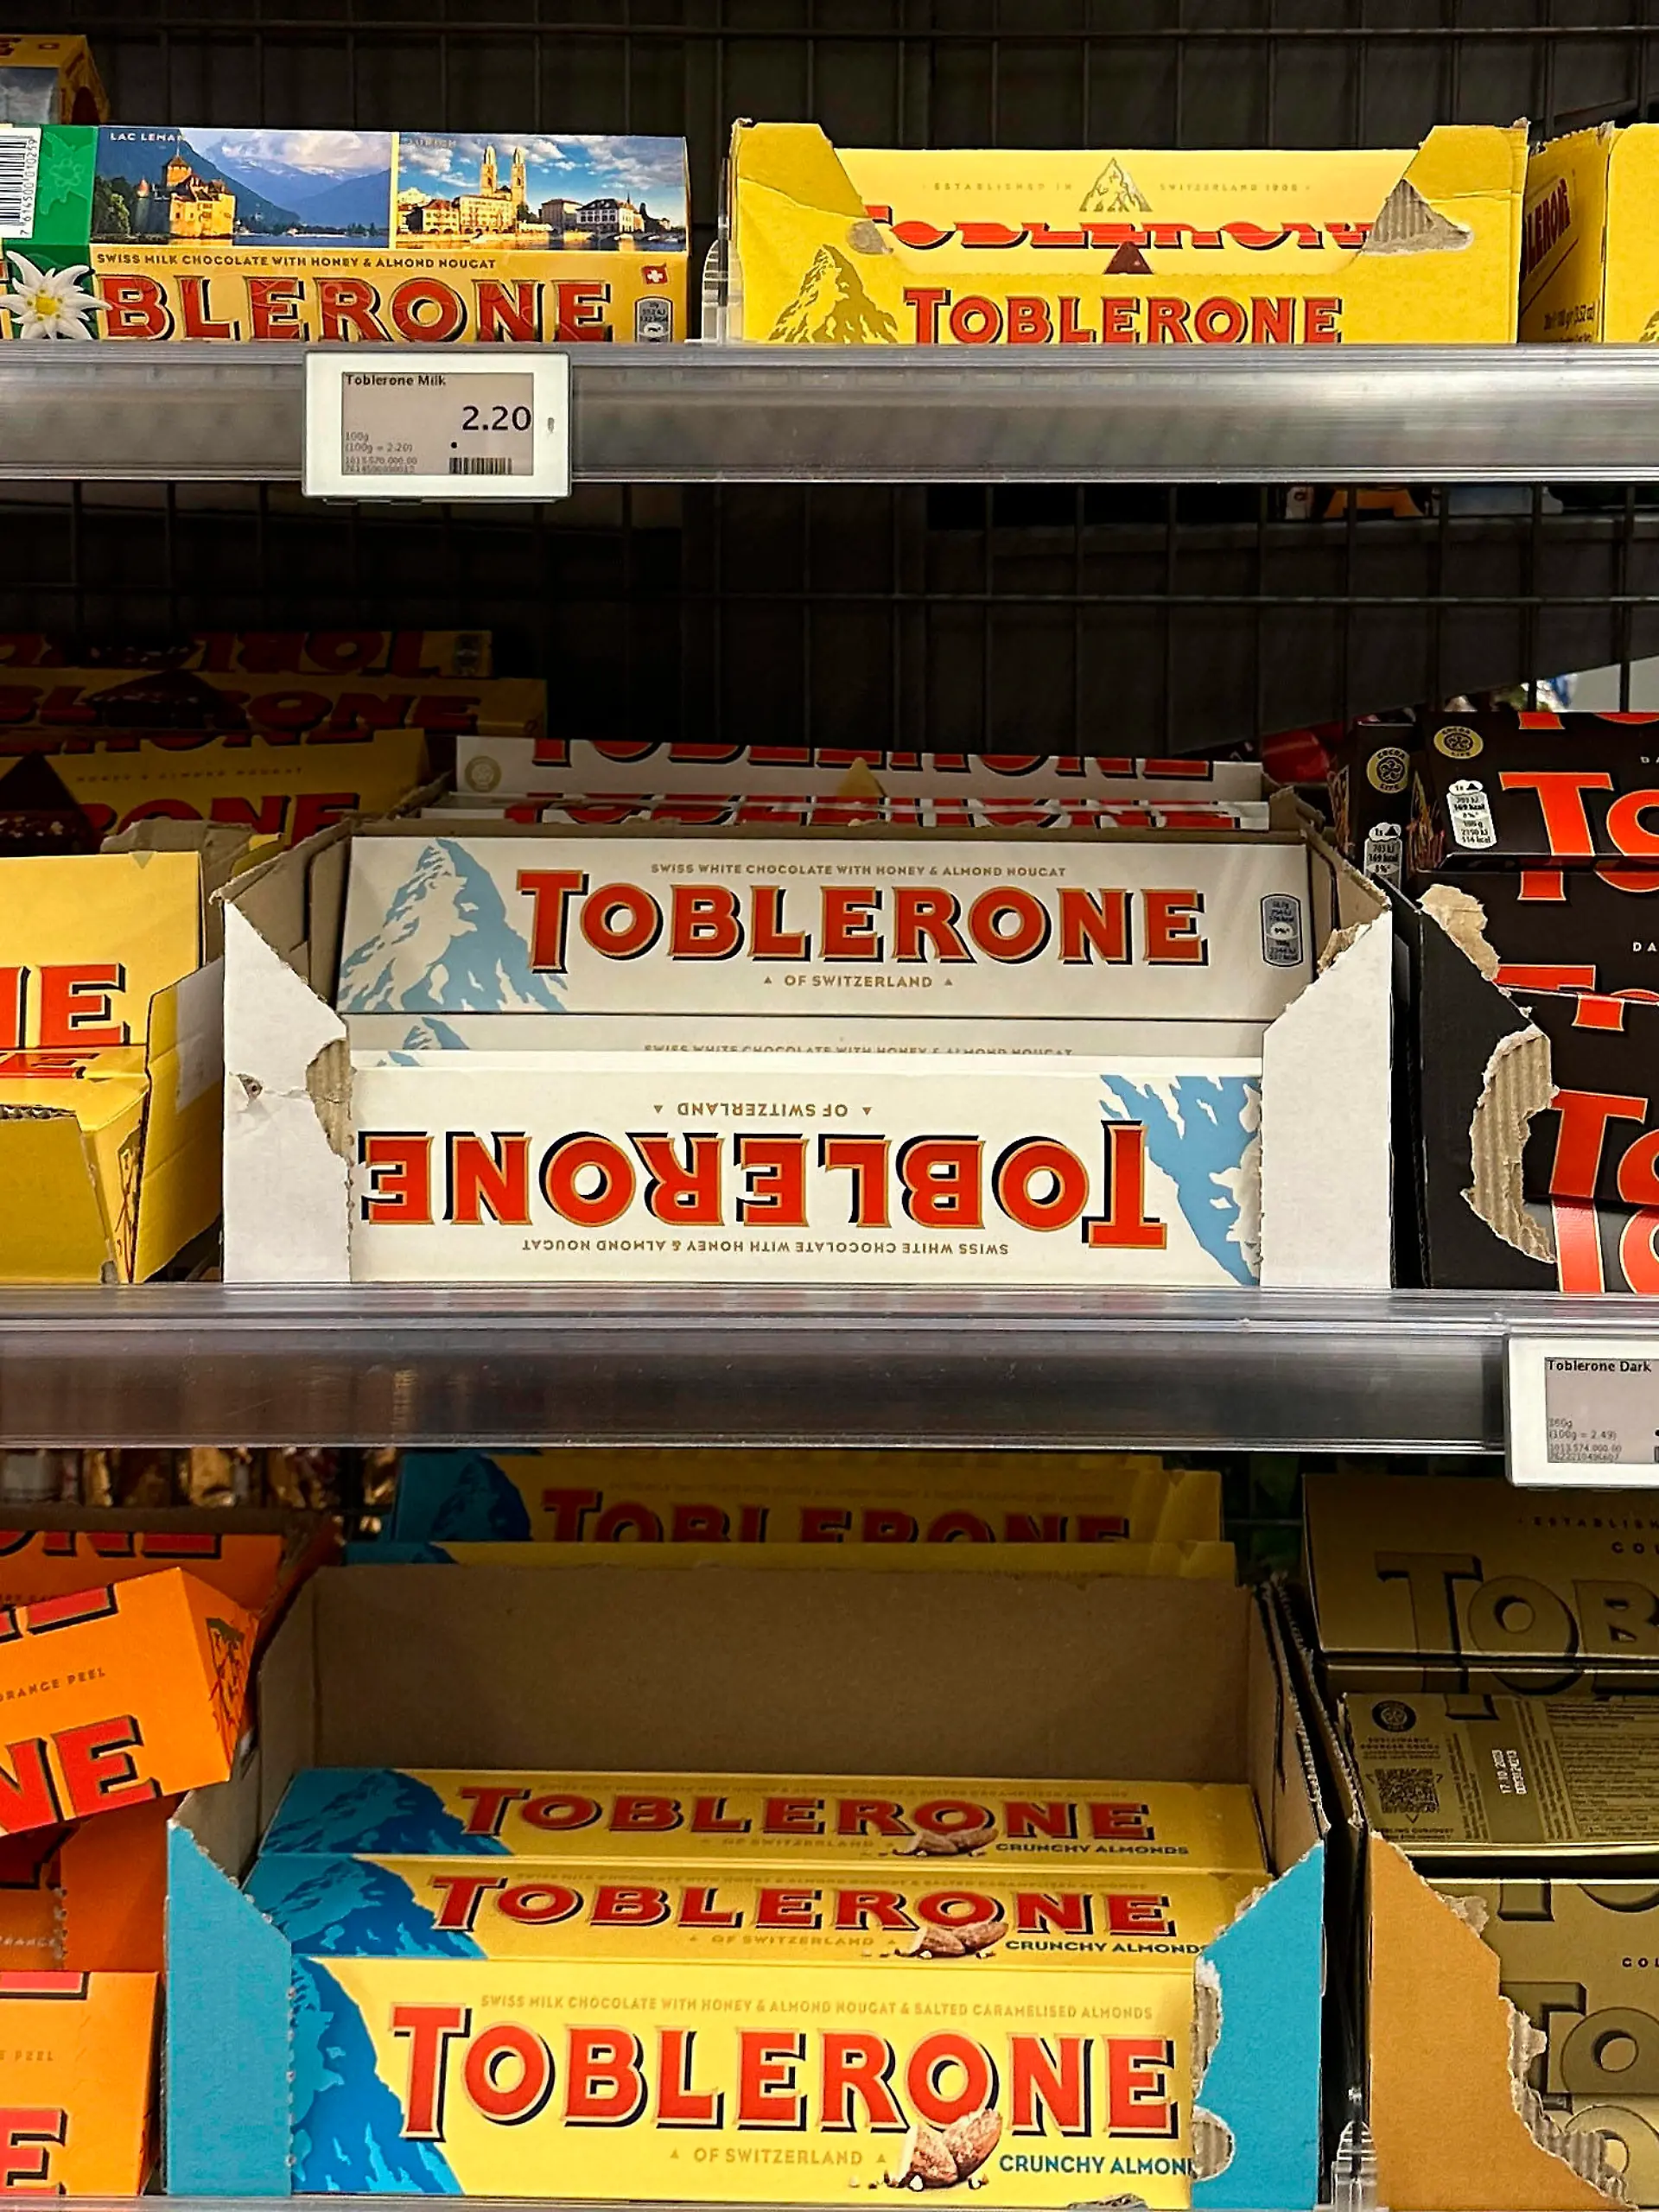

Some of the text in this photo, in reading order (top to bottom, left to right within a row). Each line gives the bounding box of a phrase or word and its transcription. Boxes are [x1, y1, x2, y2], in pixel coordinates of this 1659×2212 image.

[111, 132, 136, 141] LAC
[97, 253, 496, 269] SWISS MILK CHOCOLATE WITH HONEY & ALMOND NOUGAT
[903, 287, 1342, 344] TOBLERONE
[346, 374, 446, 386] Toblerone Milk
[462, 405, 532, 431] 2.20
[652, 864, 1066, 877] SWISS WHITE CHOCOLATE WITH HONEY & ALMOND NOUGAT
[516, 869, 1209, 974] TOBLERONE
[785, 976, 933, 988] OF SWITZERLAND
[677, 1102, 849, 1117] OF SWITZERLAND
[359, 1121, 1167, 1251] TOBLERONE
[522, 1240, 1009, 1255] SWISS WHITE CHOCOLATE WITH HONEY & ALMOND NOUGAT
[1548, 1360, 1652, 1373] Toblerone Dark
[67, 1667, 105, 1685] PEEL
[457, 1787, 1155, 1841] TOBLERONE
[995, 1842, 1189, 1856] CRUNCHY ALMONDS
[432, 1875, 1176, 1938] TOBLERONE
[743, 1935, 875, 1947] SWITZERLAND
[1006, 1940, 1106, 1953] CRUNCHY
[481, 1994, 1153, 2020] SWISS MILK CHOCOLATE WITH HONEY & ALMOND NOUGAT & SALTED CARAMELISED ALMONDS
[388, 2002, 1179, 2143] TOBLERONE
[694, 2146, 862, 2166] OF SWITZERLAND
[1000, 2154, 1104, 2175] CRUNCHY
